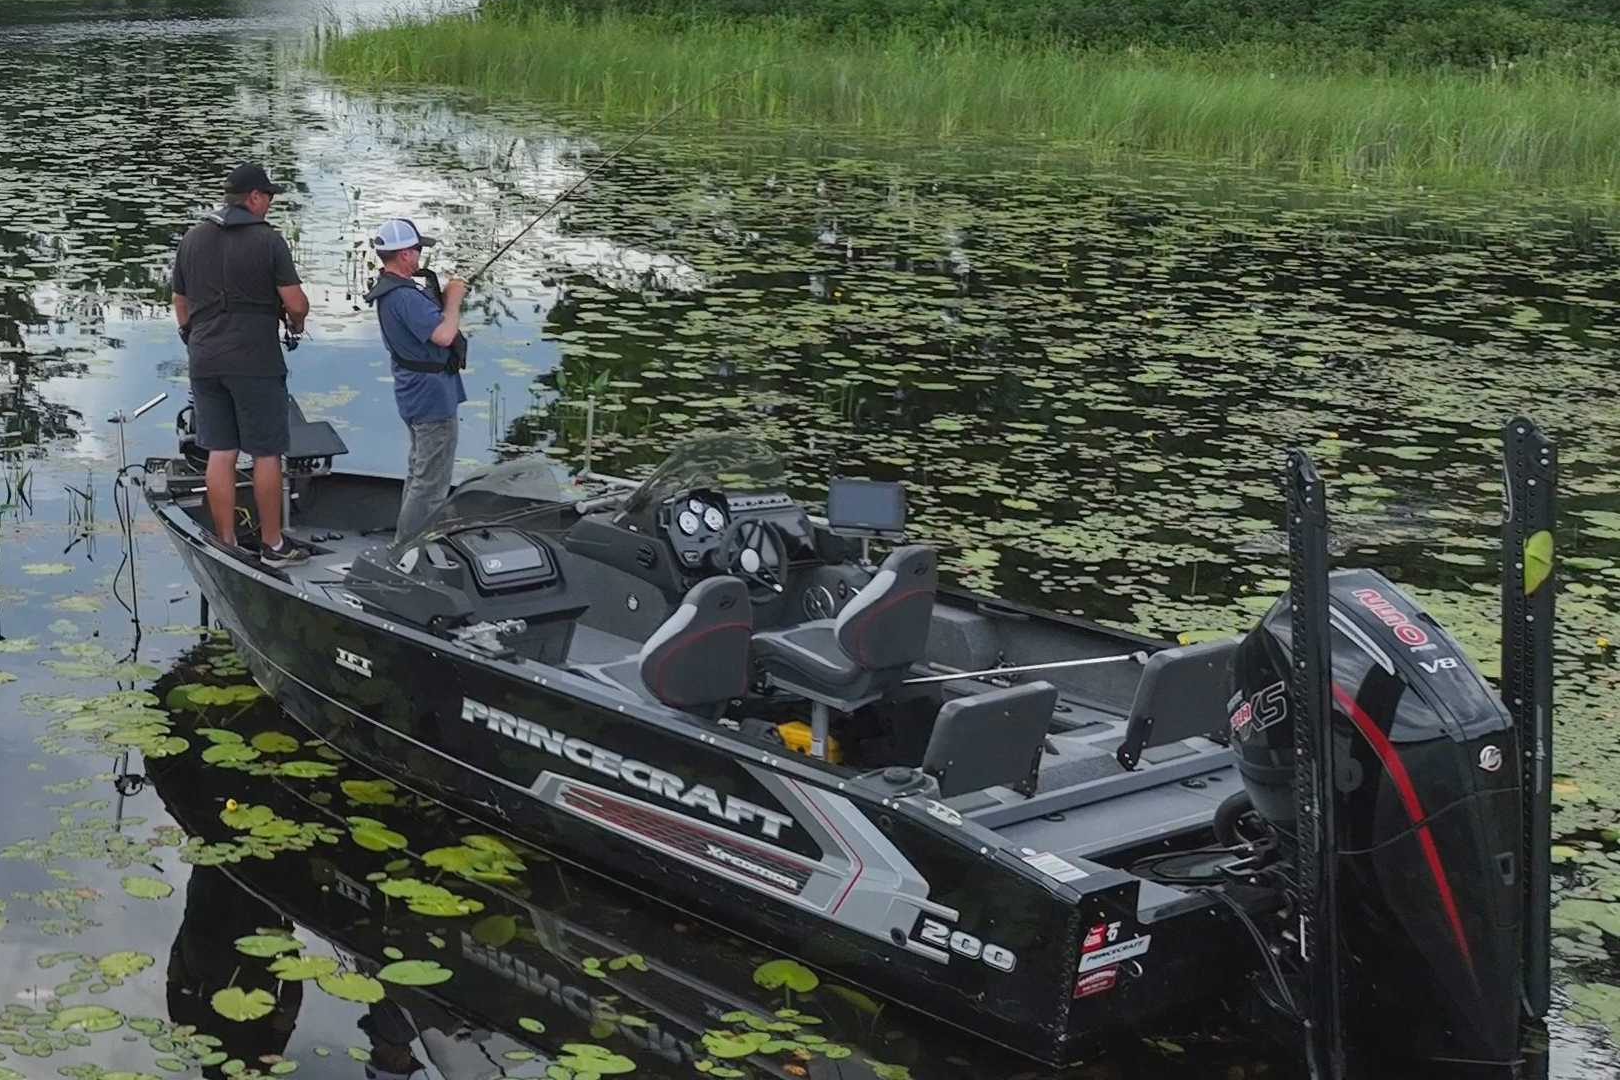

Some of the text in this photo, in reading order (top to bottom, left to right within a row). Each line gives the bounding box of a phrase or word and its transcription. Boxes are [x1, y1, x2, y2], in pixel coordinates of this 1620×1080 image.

[1418, 657, 1458, 674] V8
[461, 696, 794, 840] PRINCECRAFT
[920, 918, 1017, 973] 200
